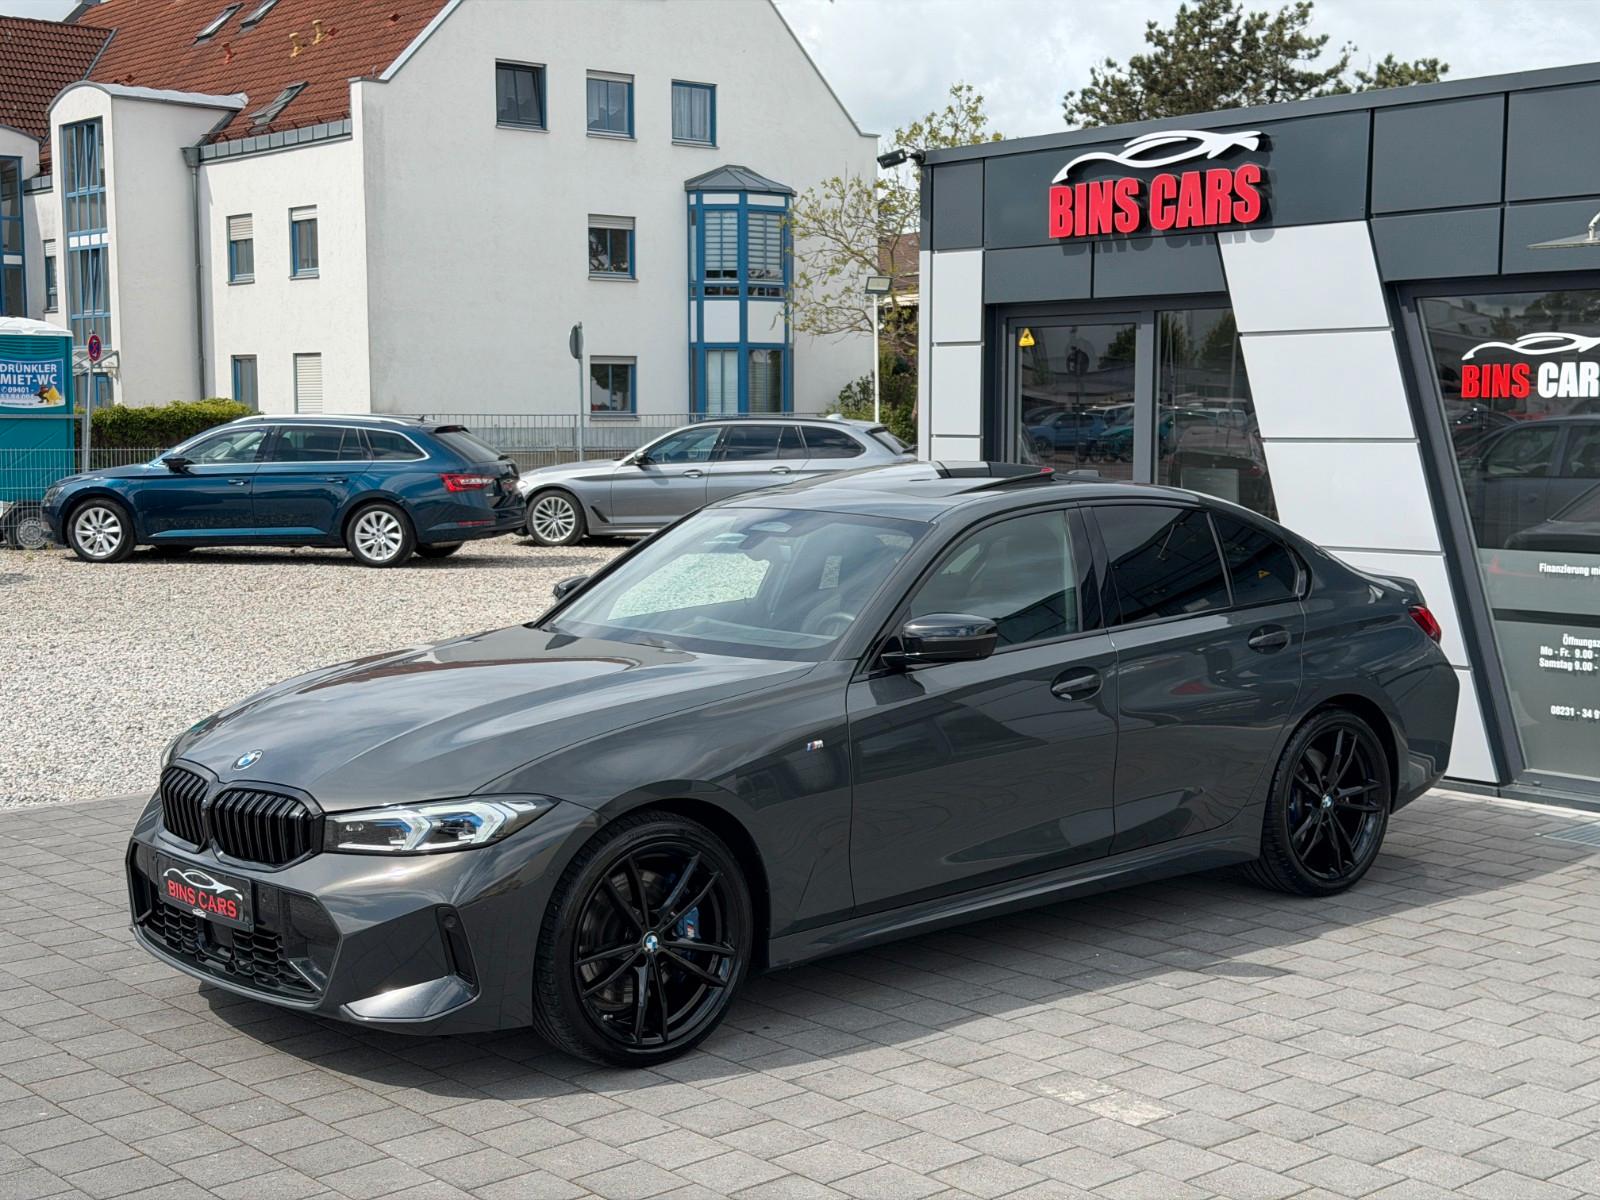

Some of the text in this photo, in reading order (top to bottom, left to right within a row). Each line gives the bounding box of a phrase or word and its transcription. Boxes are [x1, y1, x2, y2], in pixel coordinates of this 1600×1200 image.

[1049, 163, 1262, 239] BINS CARS
[0, 361, 57, 373] DRÜNKLER
[0, 373, 58, 385] MIET-WC
[1461, 361, 1600, 399] BINS CAR
[1539, 562, 1590, 577] Finanzierung
[1540, 645, 1553, 656] Mo
[1560, 647, 1571, 658] Fr.
[1574, 648, 1594, 660] 9.00
[1539, 657, 1573, 671] Samstag
[1574, 660, 1593, 671] 9.00
[1550, 704, 1575, 716] 08231
[1582, 708, 1593, 718] 34
[167, 880, 237, 918] BINS CARS
